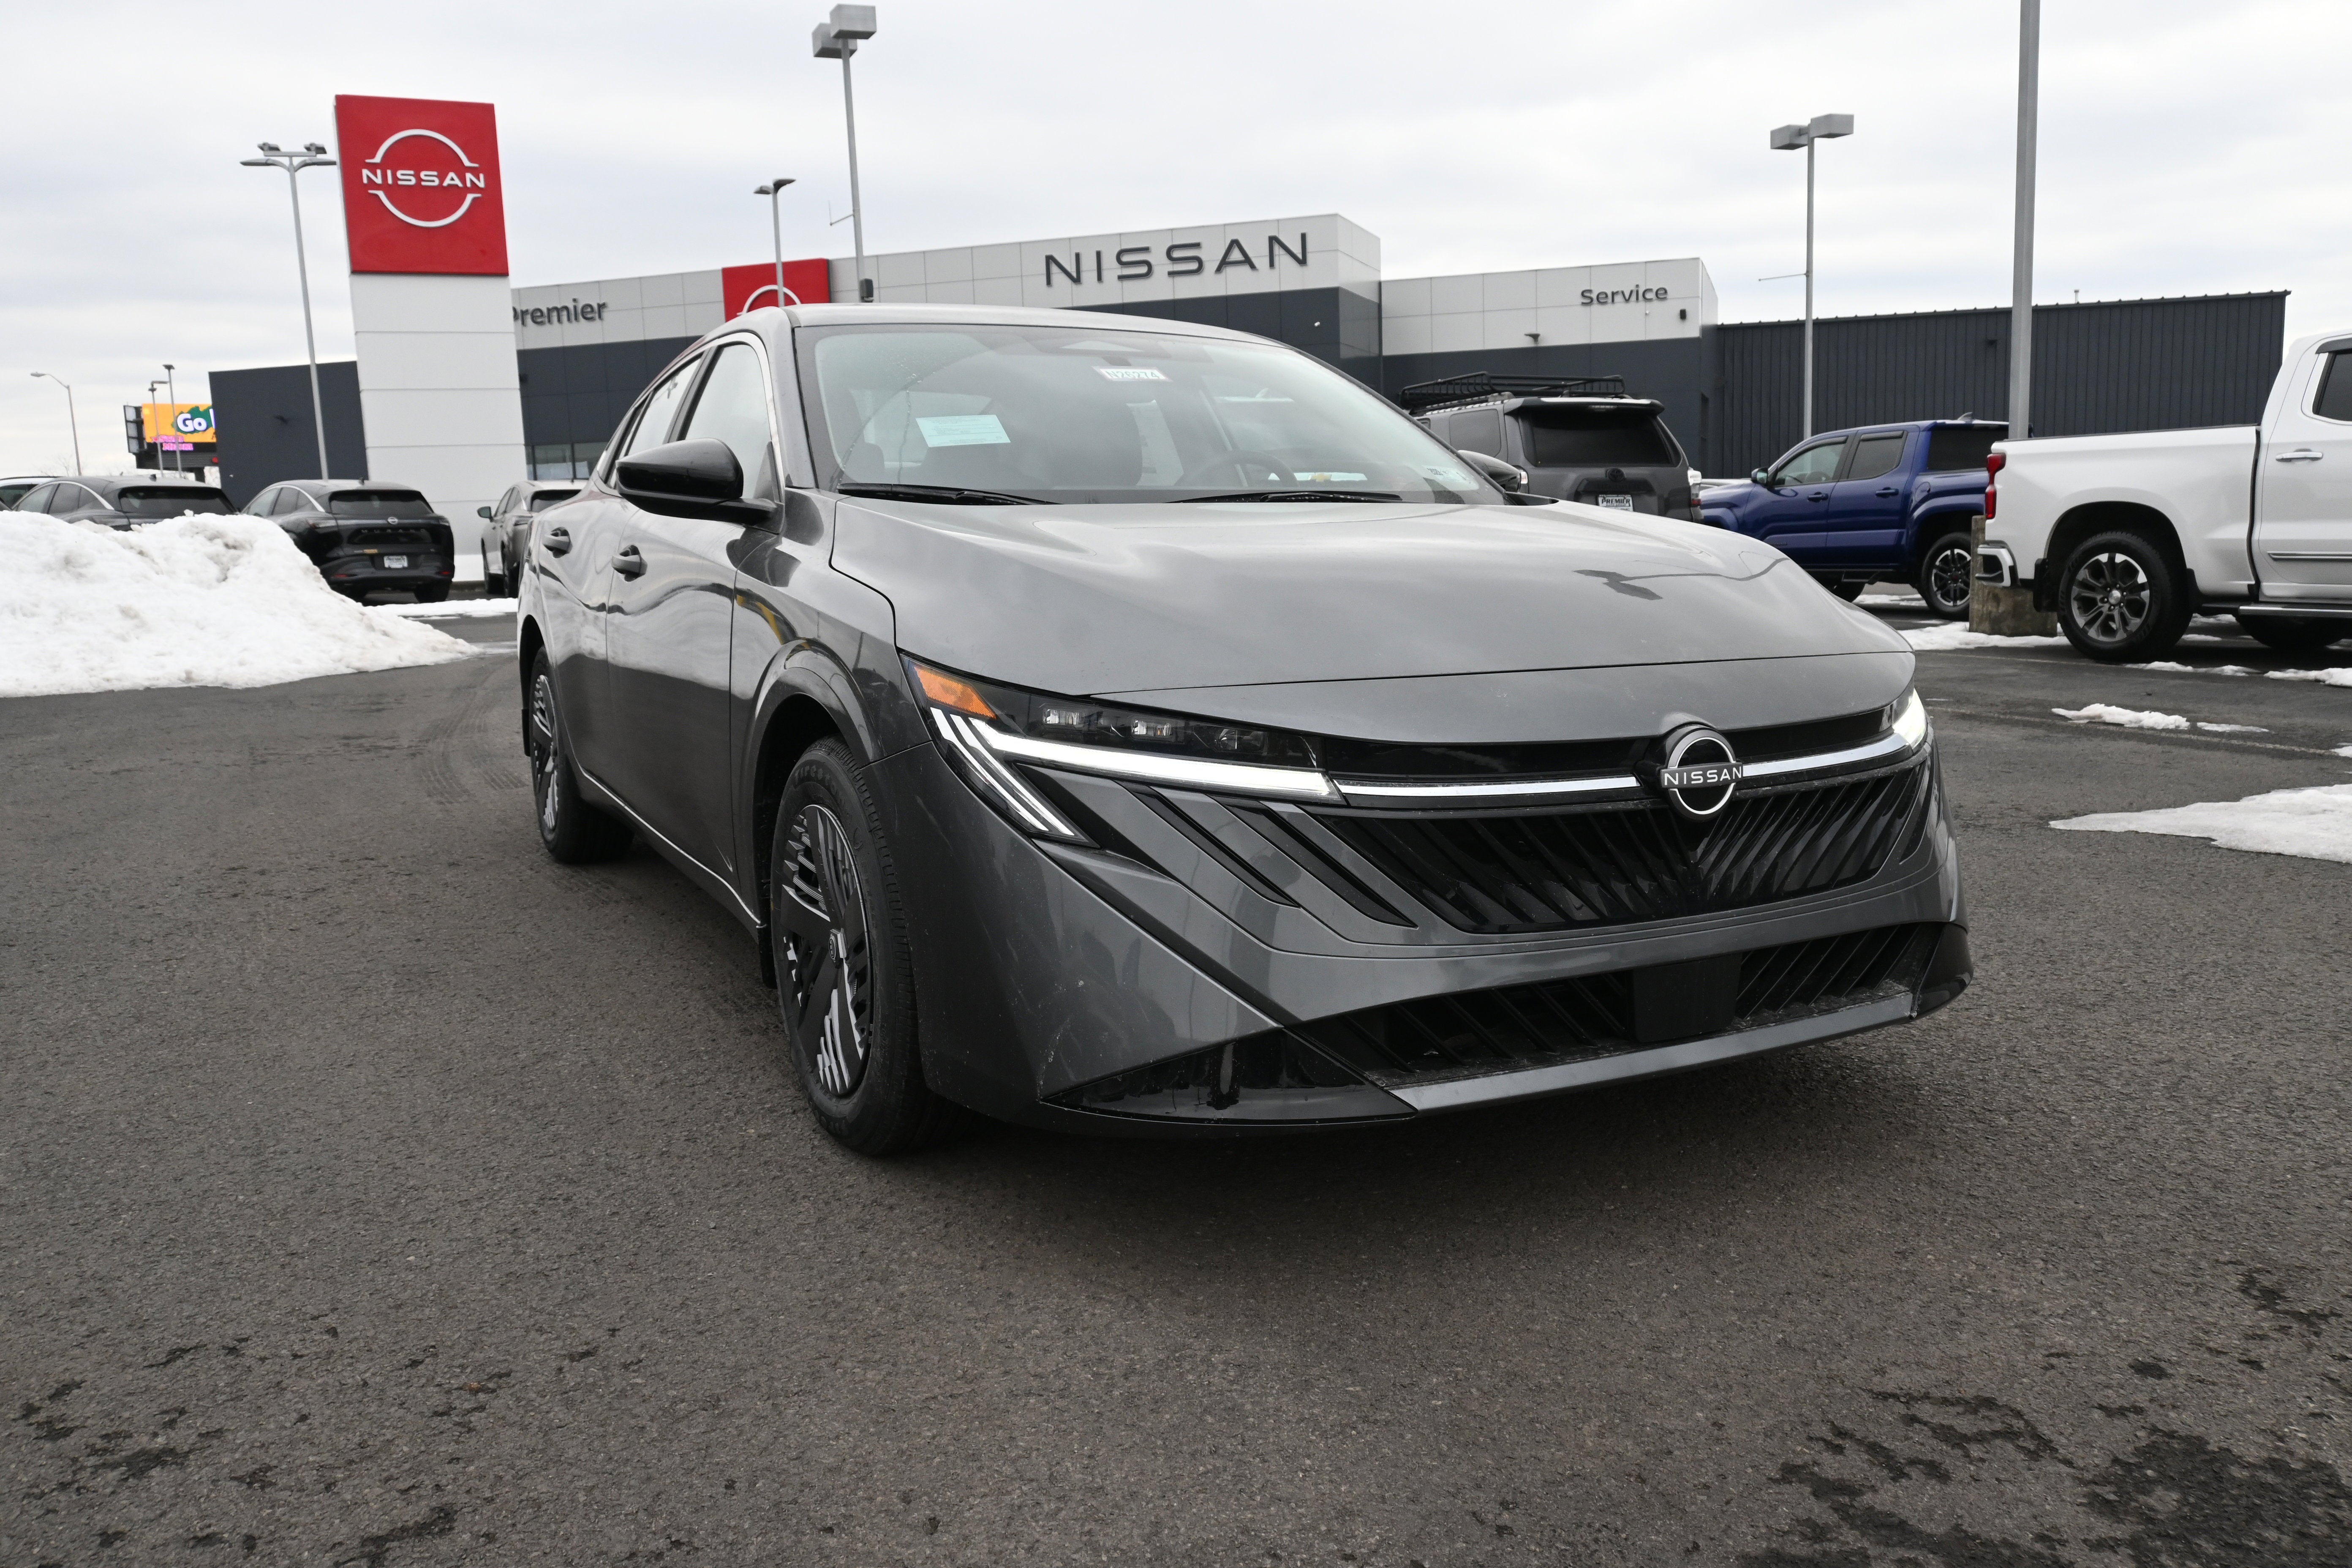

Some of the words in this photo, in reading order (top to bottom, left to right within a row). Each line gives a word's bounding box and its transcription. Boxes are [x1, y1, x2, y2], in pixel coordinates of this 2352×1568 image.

[362, 169, 485, 188] NISSAN
[1045, 232, 1308, 286] NISSAN
[1581, 284, 1668, 305] Service
[1664, 766, 1742, 786] NISSAN
